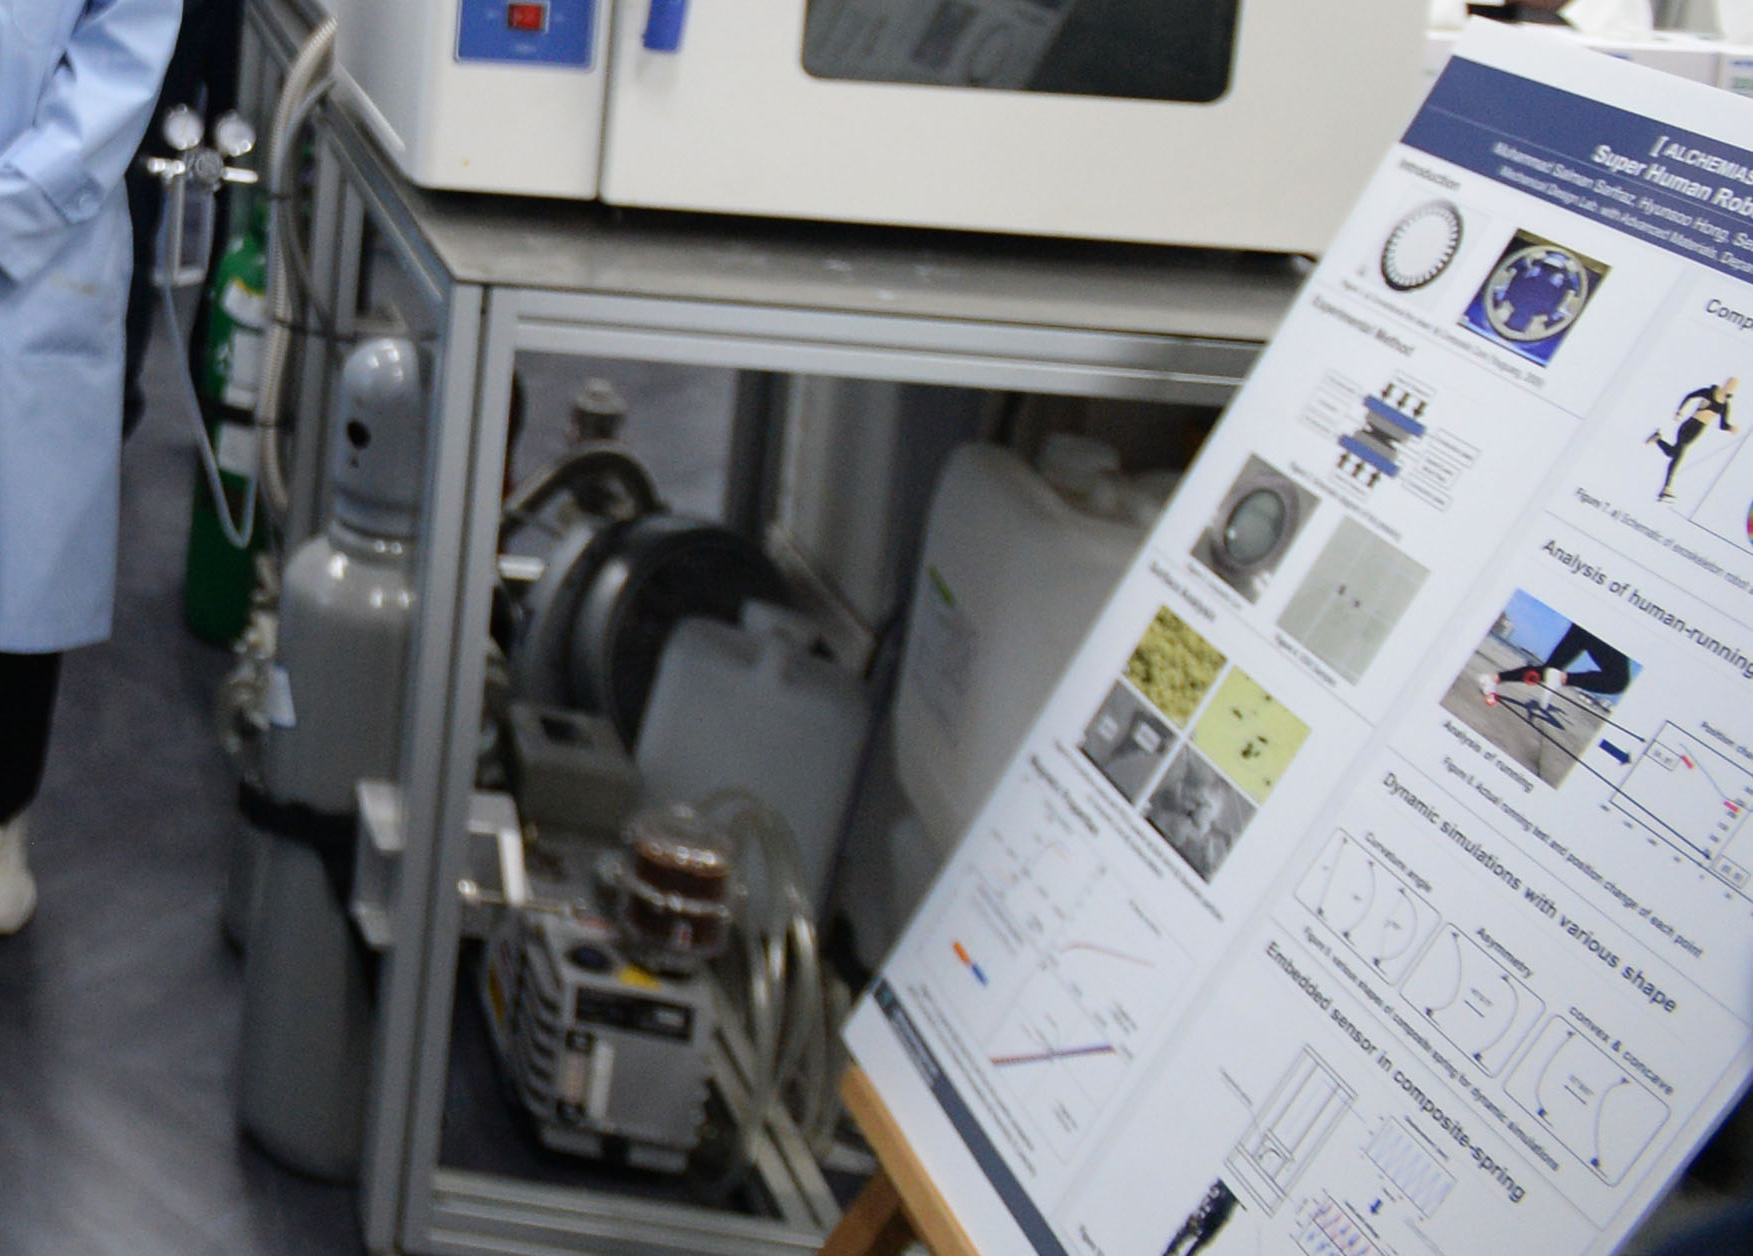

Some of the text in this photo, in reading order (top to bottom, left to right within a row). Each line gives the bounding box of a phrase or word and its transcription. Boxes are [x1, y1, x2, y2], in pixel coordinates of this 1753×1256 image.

[1591, 144, 1649, 176] Super
[1643, 163, 1713, 201] Human
[1637, 196, 1694, 227] Hyunsoo
[1541, 539, 1608, 586] Analysis
[1608, 581, 1631, 597] of
[1442, 720, 1535, 794] Analysis of running
[1365, 831, 1433, 894] Curvature angle
[1382, 771, 1677, 1013] Dynamic simulations with various shape
[1473, 782, 1503, 806] Actual
[1500, 802, 1534, 833] running
[1531, 825, 1551, 844] test
[1548, 839, 1569, 857] and
[1565, 853, 1604, 884] position
[1602, 880, 1639, 911] change
[1637, 907, 1653, 920] of
[1649, 916, 1676, 938] each
[1673, 934, 1704, 959] point
[1475, 927, 1534, 980] Asymmetry
[1265, 940, 1333, 1012] Embedded
[1329, 1008, 1378, 1055] sensor
[1376, 1050, 1393, 1073] in
[1392, 1070, 1527, 1204] composite-spring
[1331, 955, 1359, 984] various
[1356, 979, 1384, 1008] shapes
[1382, 1004, 1395, 1016] of
[1391, 1013, 1434, 1054] composite
[1431, 1049, 1460, 1080] spring
[1457, 1072, 1473, 1089] for
[1470, 1087, 1509, 1124] dynamic
[1506, 1120, 1560, 1172] simulations
[1568, 1006, 1611, 1044] convex
[1611, 1039, 1623, 1053] &
[1622, 1051, 1674, 1096] concave
